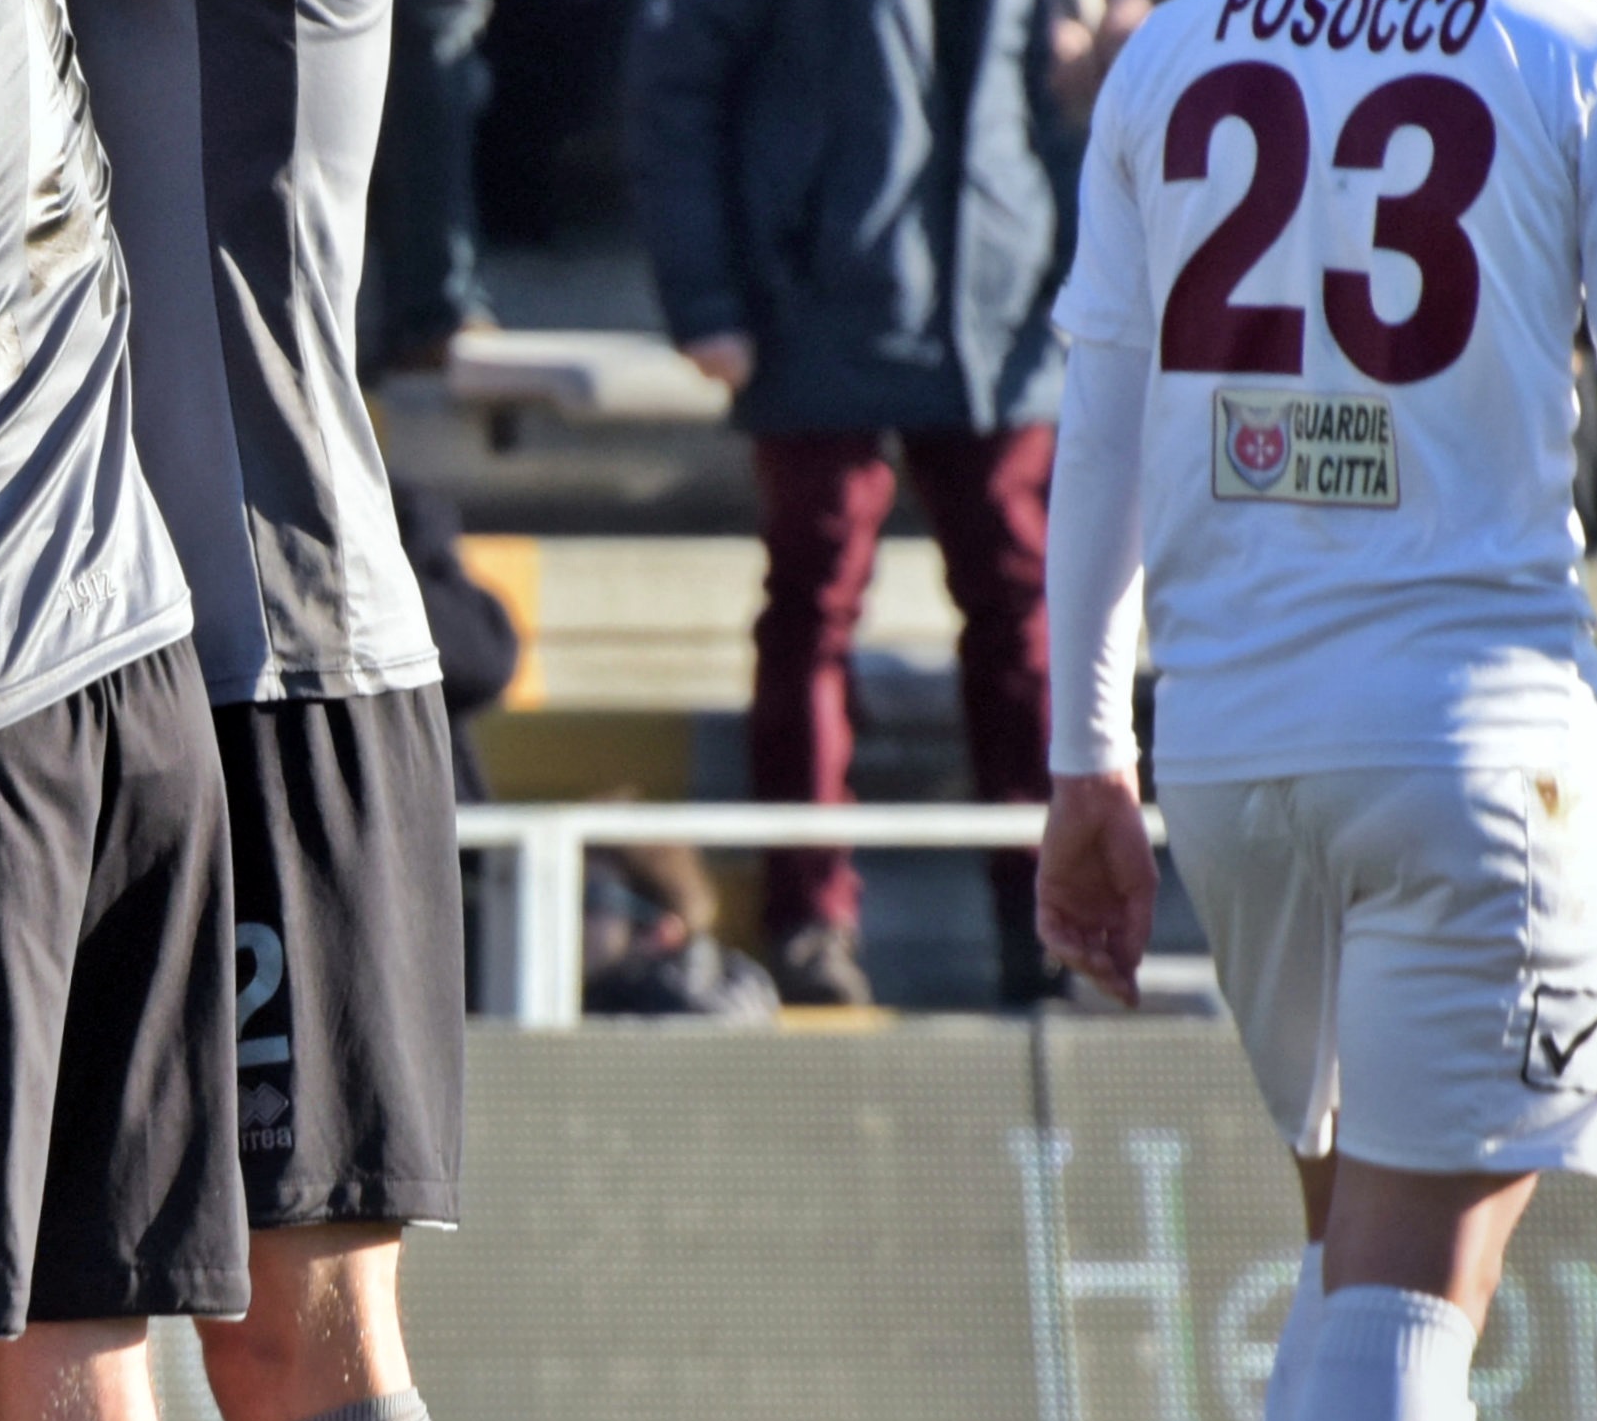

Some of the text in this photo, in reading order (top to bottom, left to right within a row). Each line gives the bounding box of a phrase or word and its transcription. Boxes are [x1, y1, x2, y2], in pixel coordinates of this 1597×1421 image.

[1160, 59, 1497, 386] 23
[1294, 402, 1389, 444] GUARDIE
[1317, 447, 1388, 497] CITTÀ
